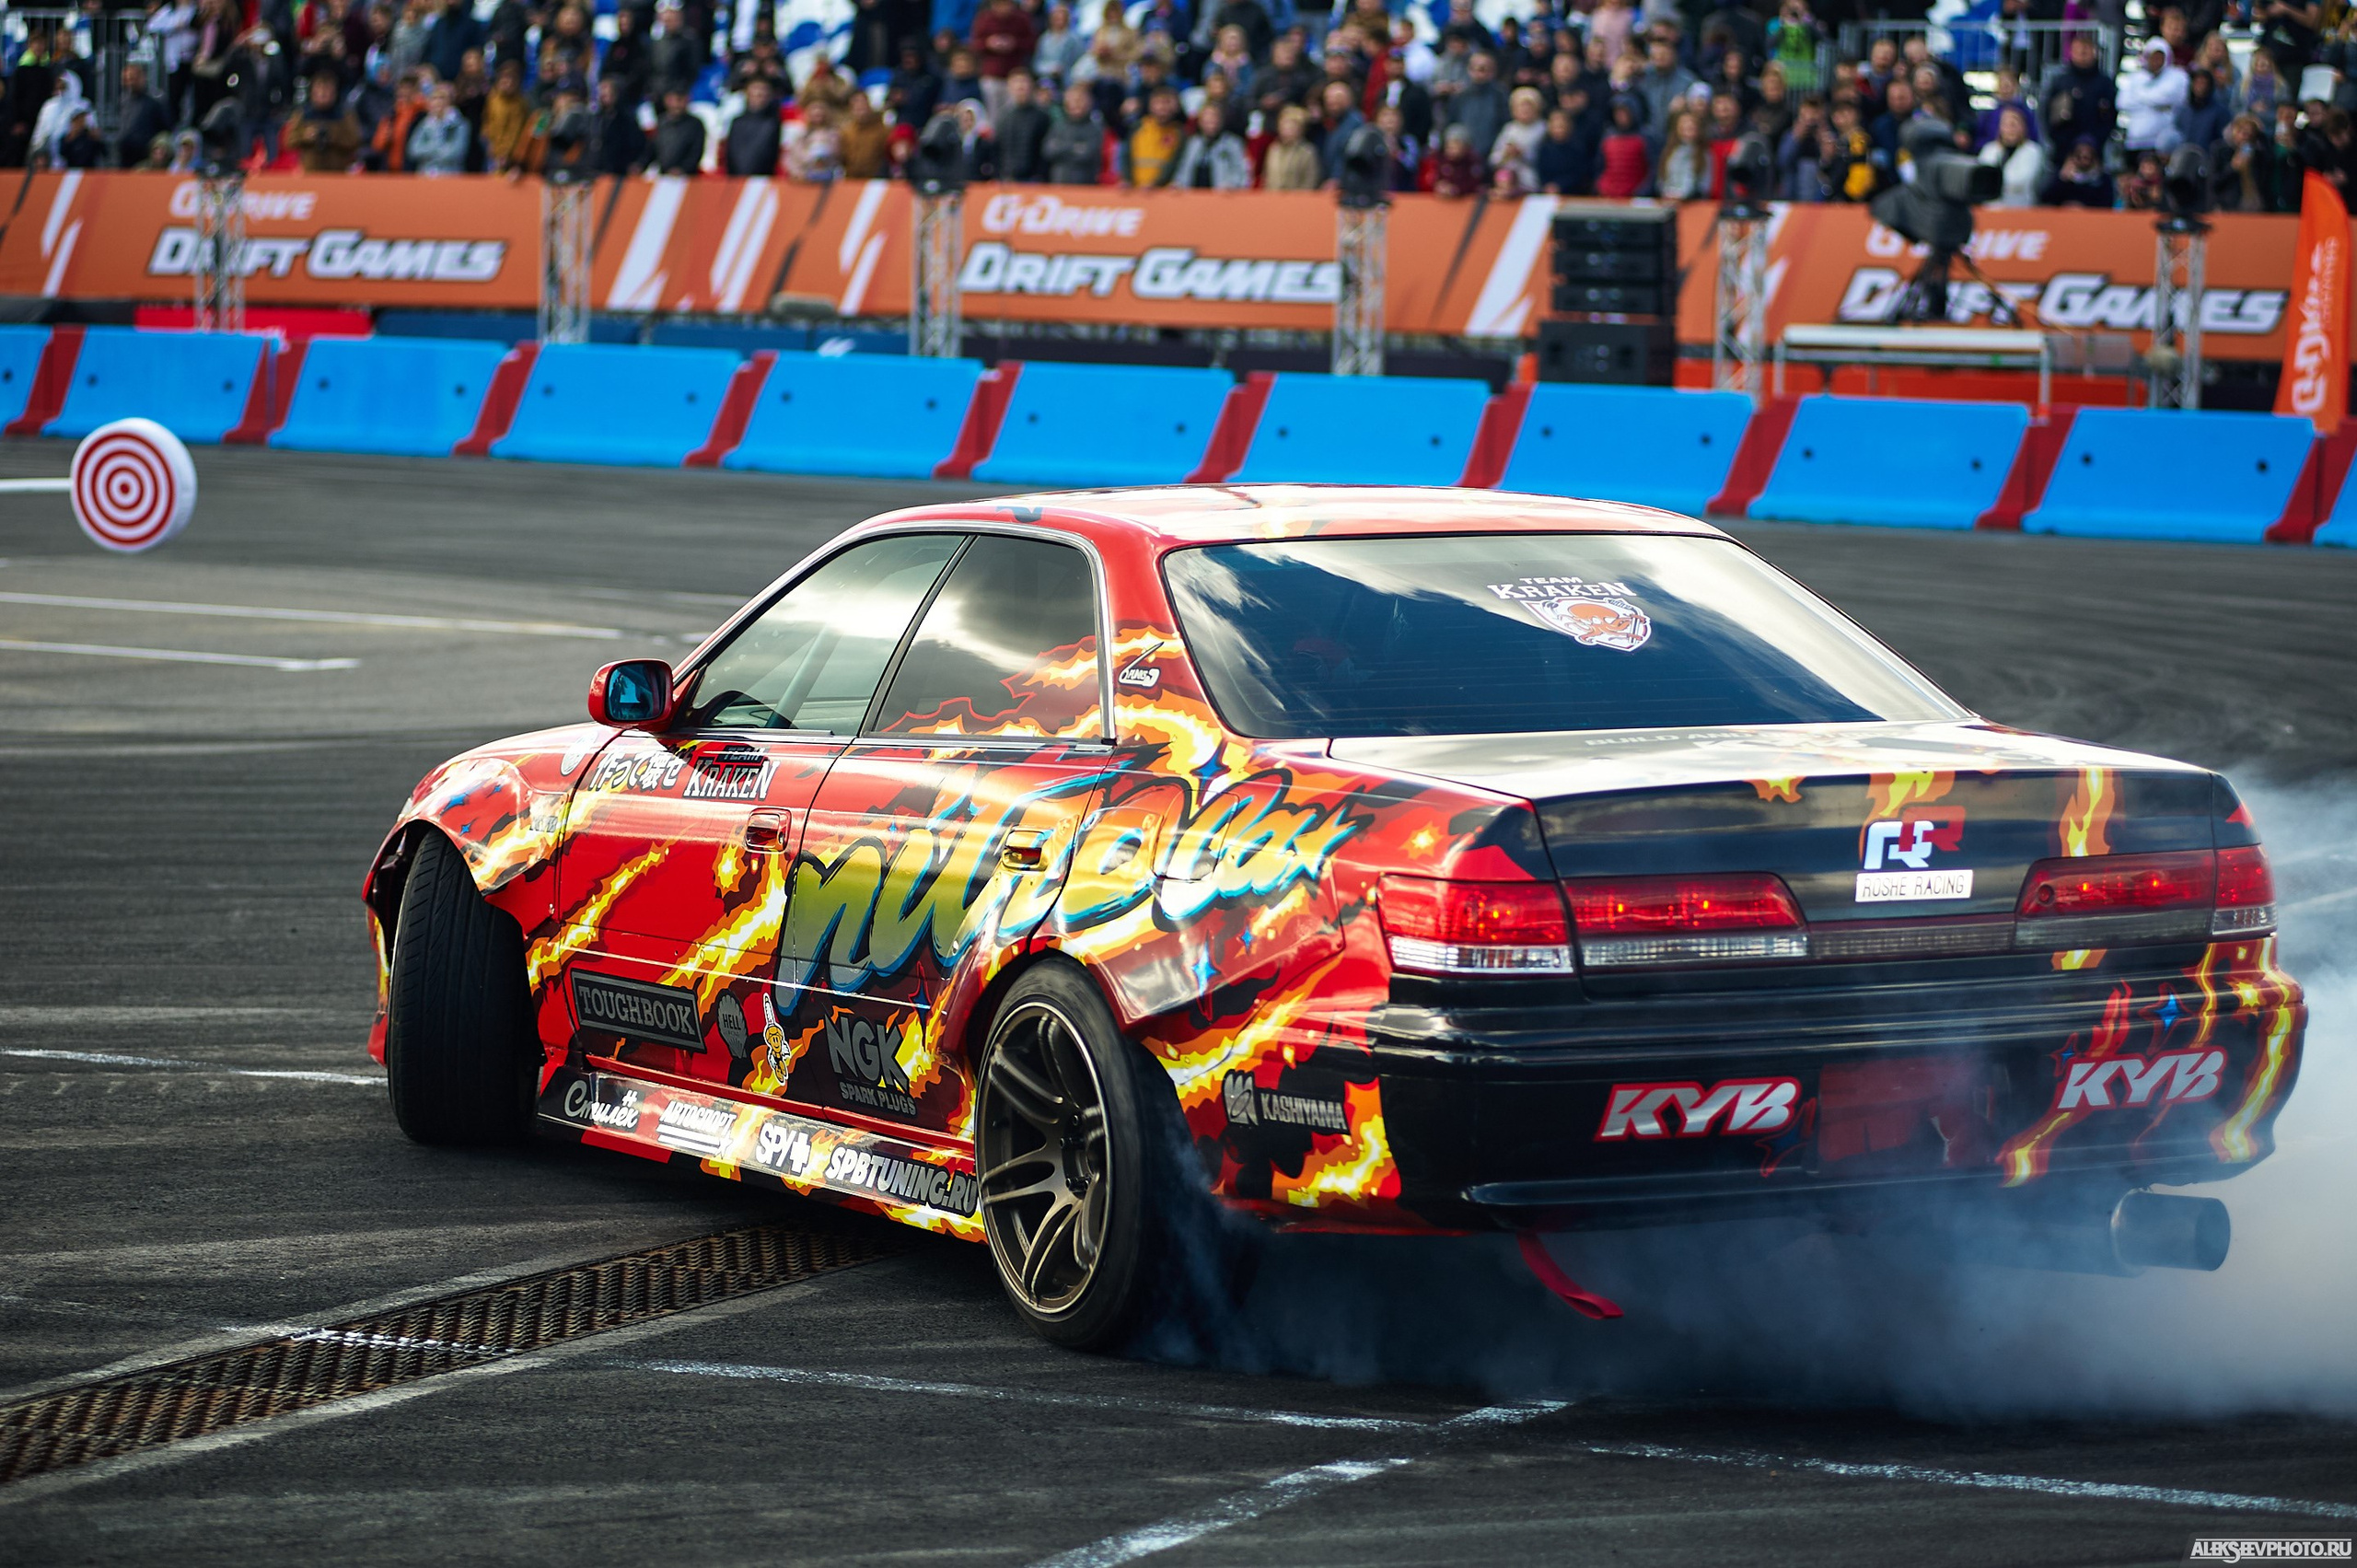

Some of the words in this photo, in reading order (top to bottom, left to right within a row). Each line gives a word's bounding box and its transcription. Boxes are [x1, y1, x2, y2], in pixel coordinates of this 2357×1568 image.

[307, 228, 507, 281] GAMES
[958, 241, 1135, 296] DRIFT
[1132, 247, 1342, 302] GAMES
[1486, 582, 1637, 599] KRAKEN
[1518, 576, 1584, 585] TEAM
[722, 746, 766, 761] TEAM
[1585, 734, 1679, 747] BUILD
[683, 759, 781, 800] KRAKEN
[1863, 877, 1907, 898] ROSHE
[1914, 875, 1964, 896] RACING
[578, 984, 696, 1036] TOUGHBOOK
[722, 1013, 742, 1030] HELL
[824, 1013, 910, 1093] NGK
[839, 1082, 878, 1107] SPARK
[877, 1090, 917, 1116] PLUGS
[2057, 1050, 2224, 1109] KYB
[1260, 1092, 1348, 1131] KASHIYAMA
[1600, 1081, 1797, 1137] KYB
[826, 1146, 978, 1214] SPBTUNING.RU
